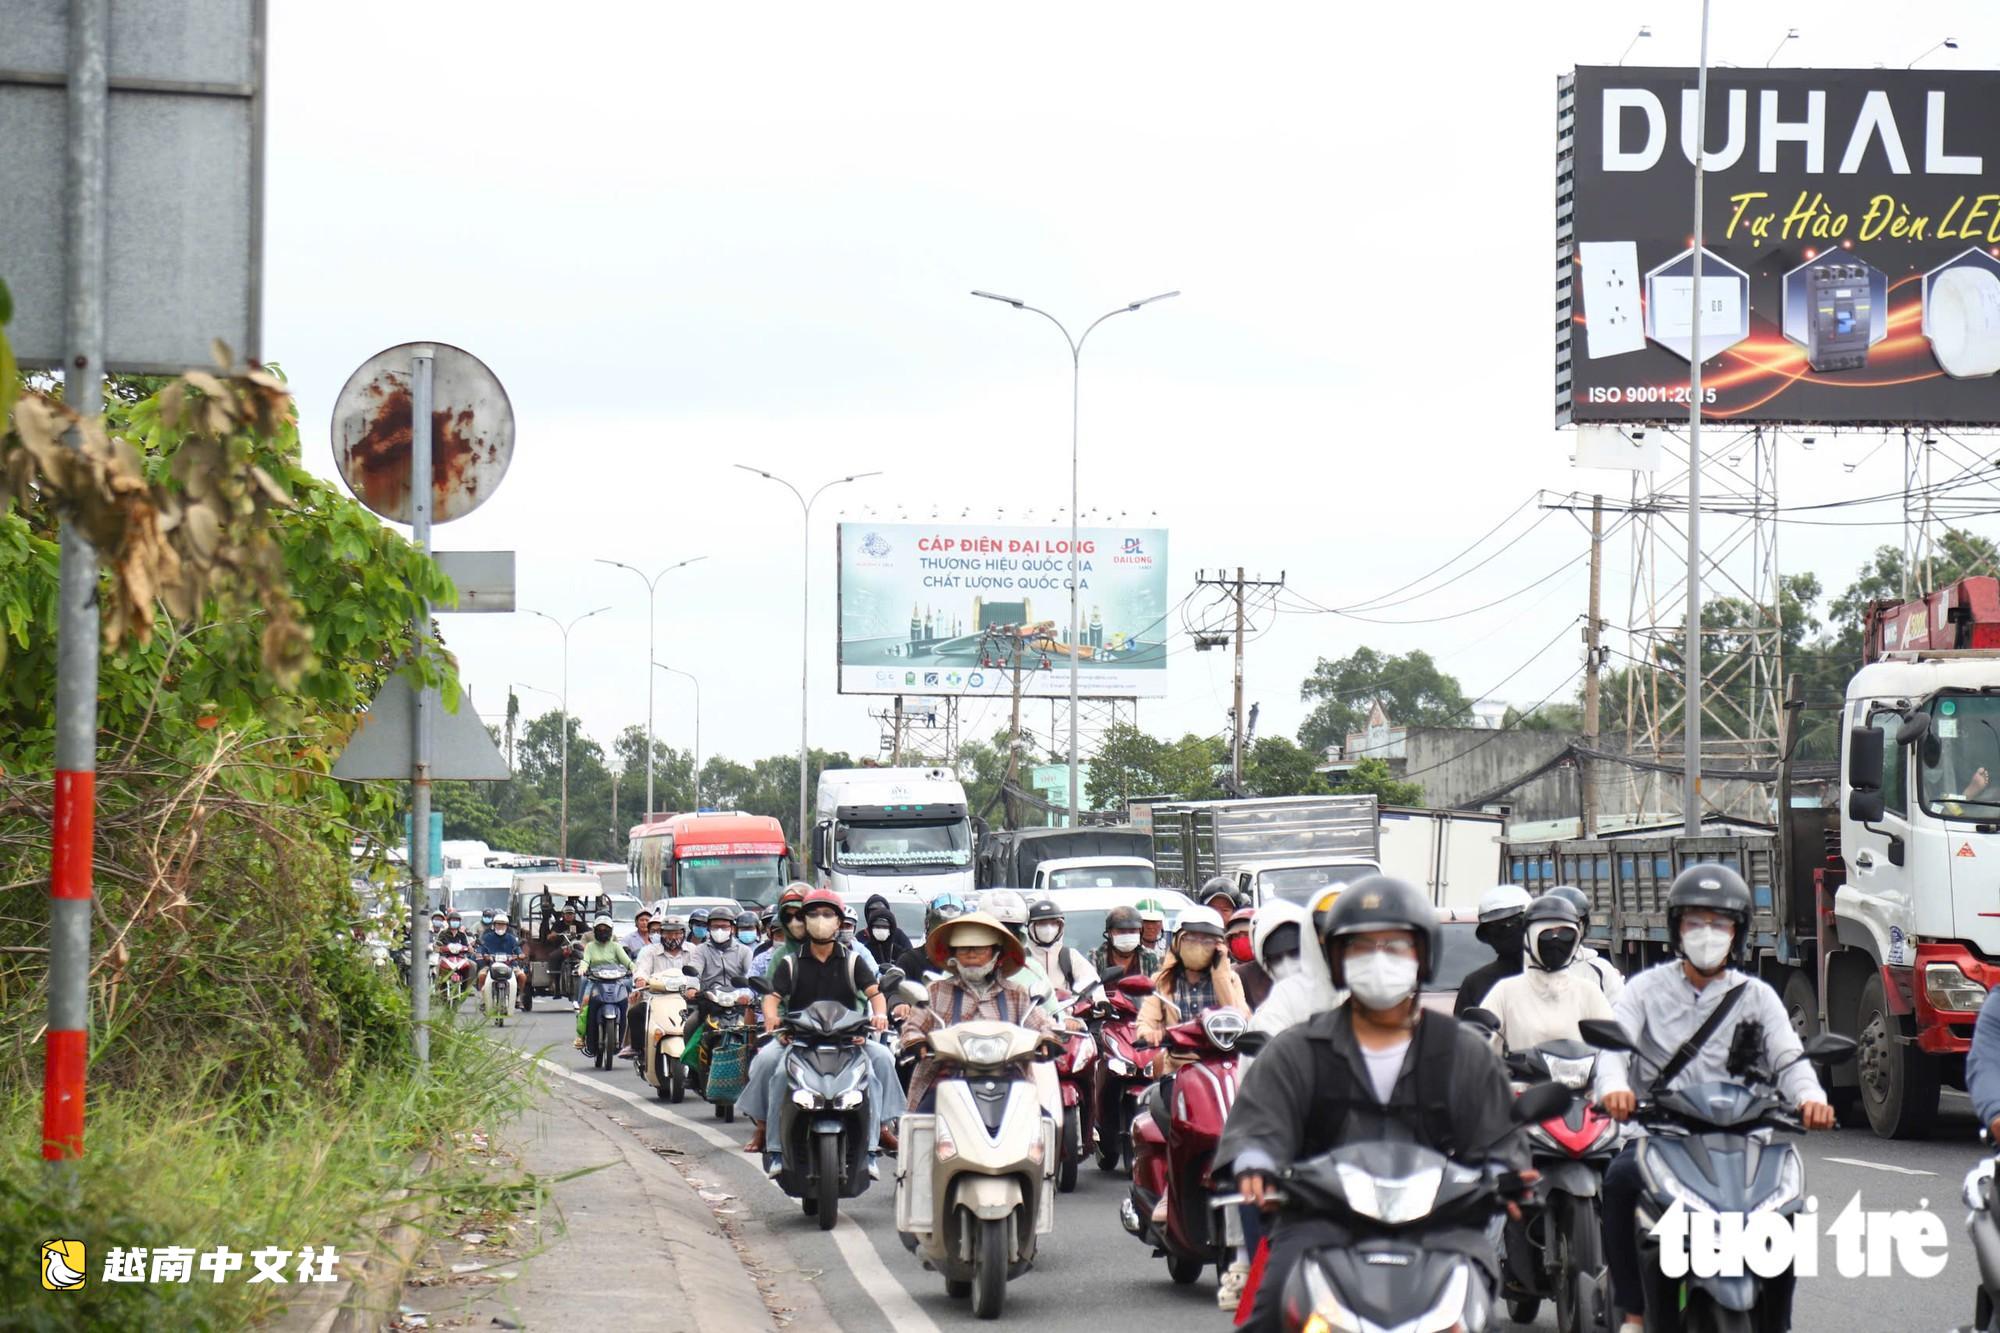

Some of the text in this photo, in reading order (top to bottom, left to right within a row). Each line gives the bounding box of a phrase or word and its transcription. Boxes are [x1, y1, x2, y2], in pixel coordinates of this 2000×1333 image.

[1602, 88, 1983, 175] DUHAL
[1726, 192, 1776, 248] Tự
[1781, 190, 1849, 241] Hào
[1858, 194, 1930, 242] Đèn
[1589, 386, 1622, 403] ISO
[918, 535, 955, 552] CÁP
[960, 535, 1003, 556] ĐIỆN
[1008, 539, 1040, 557] ĐẠI
[920, 556, 981, 571] THƯƠNG
[985, 556, 1018, 573] HIỆU
[1022, 554, 1064, 572] QUỐC
[1113, 556, 1153, 564] DAILONG
[923, 571, 1089, 592] CHẤT LƯỢNG QUỐC GA
